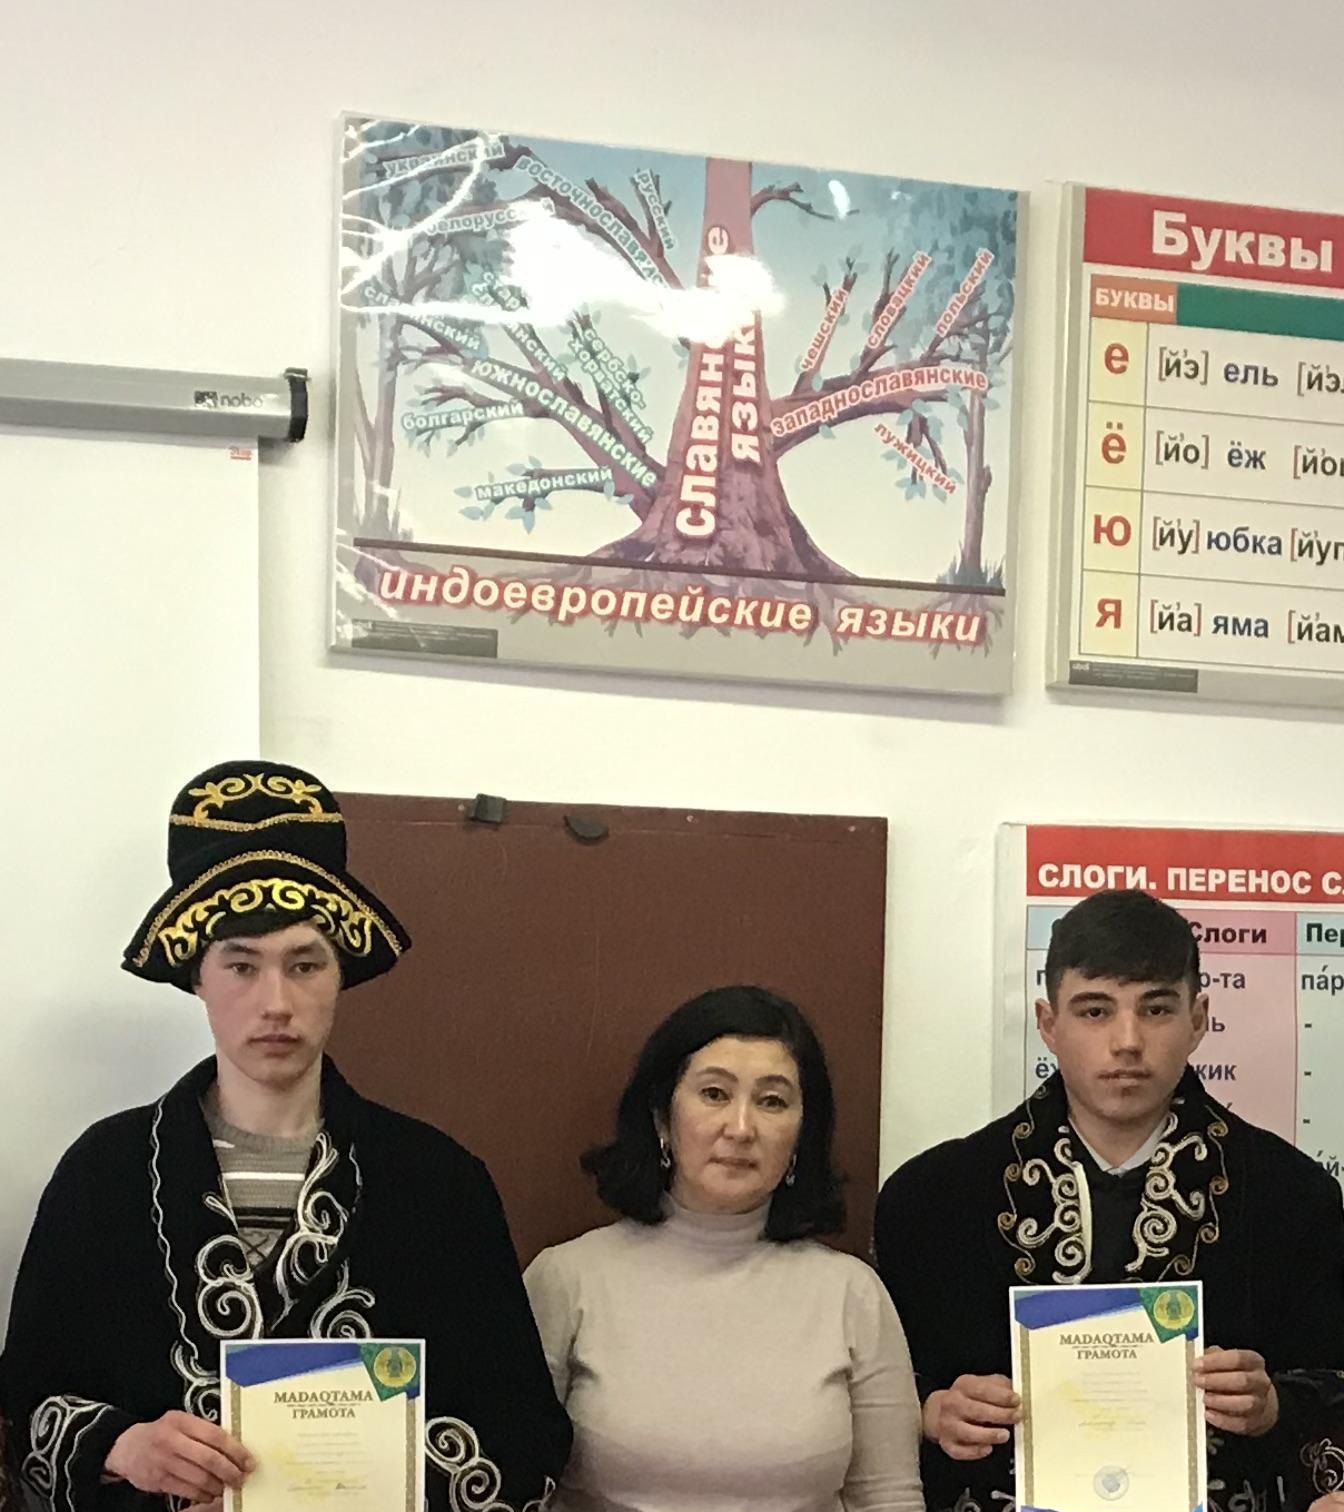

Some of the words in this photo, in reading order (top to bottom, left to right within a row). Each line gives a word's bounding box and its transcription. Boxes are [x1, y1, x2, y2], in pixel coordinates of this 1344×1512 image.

[639, 168, 675, 249] русский
[1152, 208, 1334, 273] Буквы
[868, 251, 931, 348] словацкий
[936, 249, 993, 336] польский
[1094, 288, 1175, 313] БУКВЫ
[801, 288, 848, 370] чешский
[1103, 342, 1130, 375] е
[1222, 362, 1279, 387] ель
[570, 337, 654, 443] хорватский
[771, 367, 988, 437] западнославянские
[403, 400, 524, 431] болгарский
[471, 358, 657, 487] южнославянские
[874, 423, 956, 494] лужицкий
[1100, 420, 1127, 465] ё
[1226, 440, 1267, 471] ёж
[476, 466, 613, 500] македонский
[1206, 526, 1283, 556] юбка
[379, 567, 813, 631] индоевропейские
[836, 607, 981, 643] языки
[1212, 614, 1270, 639] яма
[1038, 863, 1157, 889] СЛОГИ.
[1167, 866, 1312, 895] ПЕРЕНОС
[1189, 921, 1267, 944] Слоги
[1059, 1332, 1155, 1348] MADAQTAMA
[1076, 1349, 1138, 1360] ГРАМОТА
[273, 1389, 374, 1405] MADAQTAMA
[292, 1407, 356, 1420] ГРАМОТА
